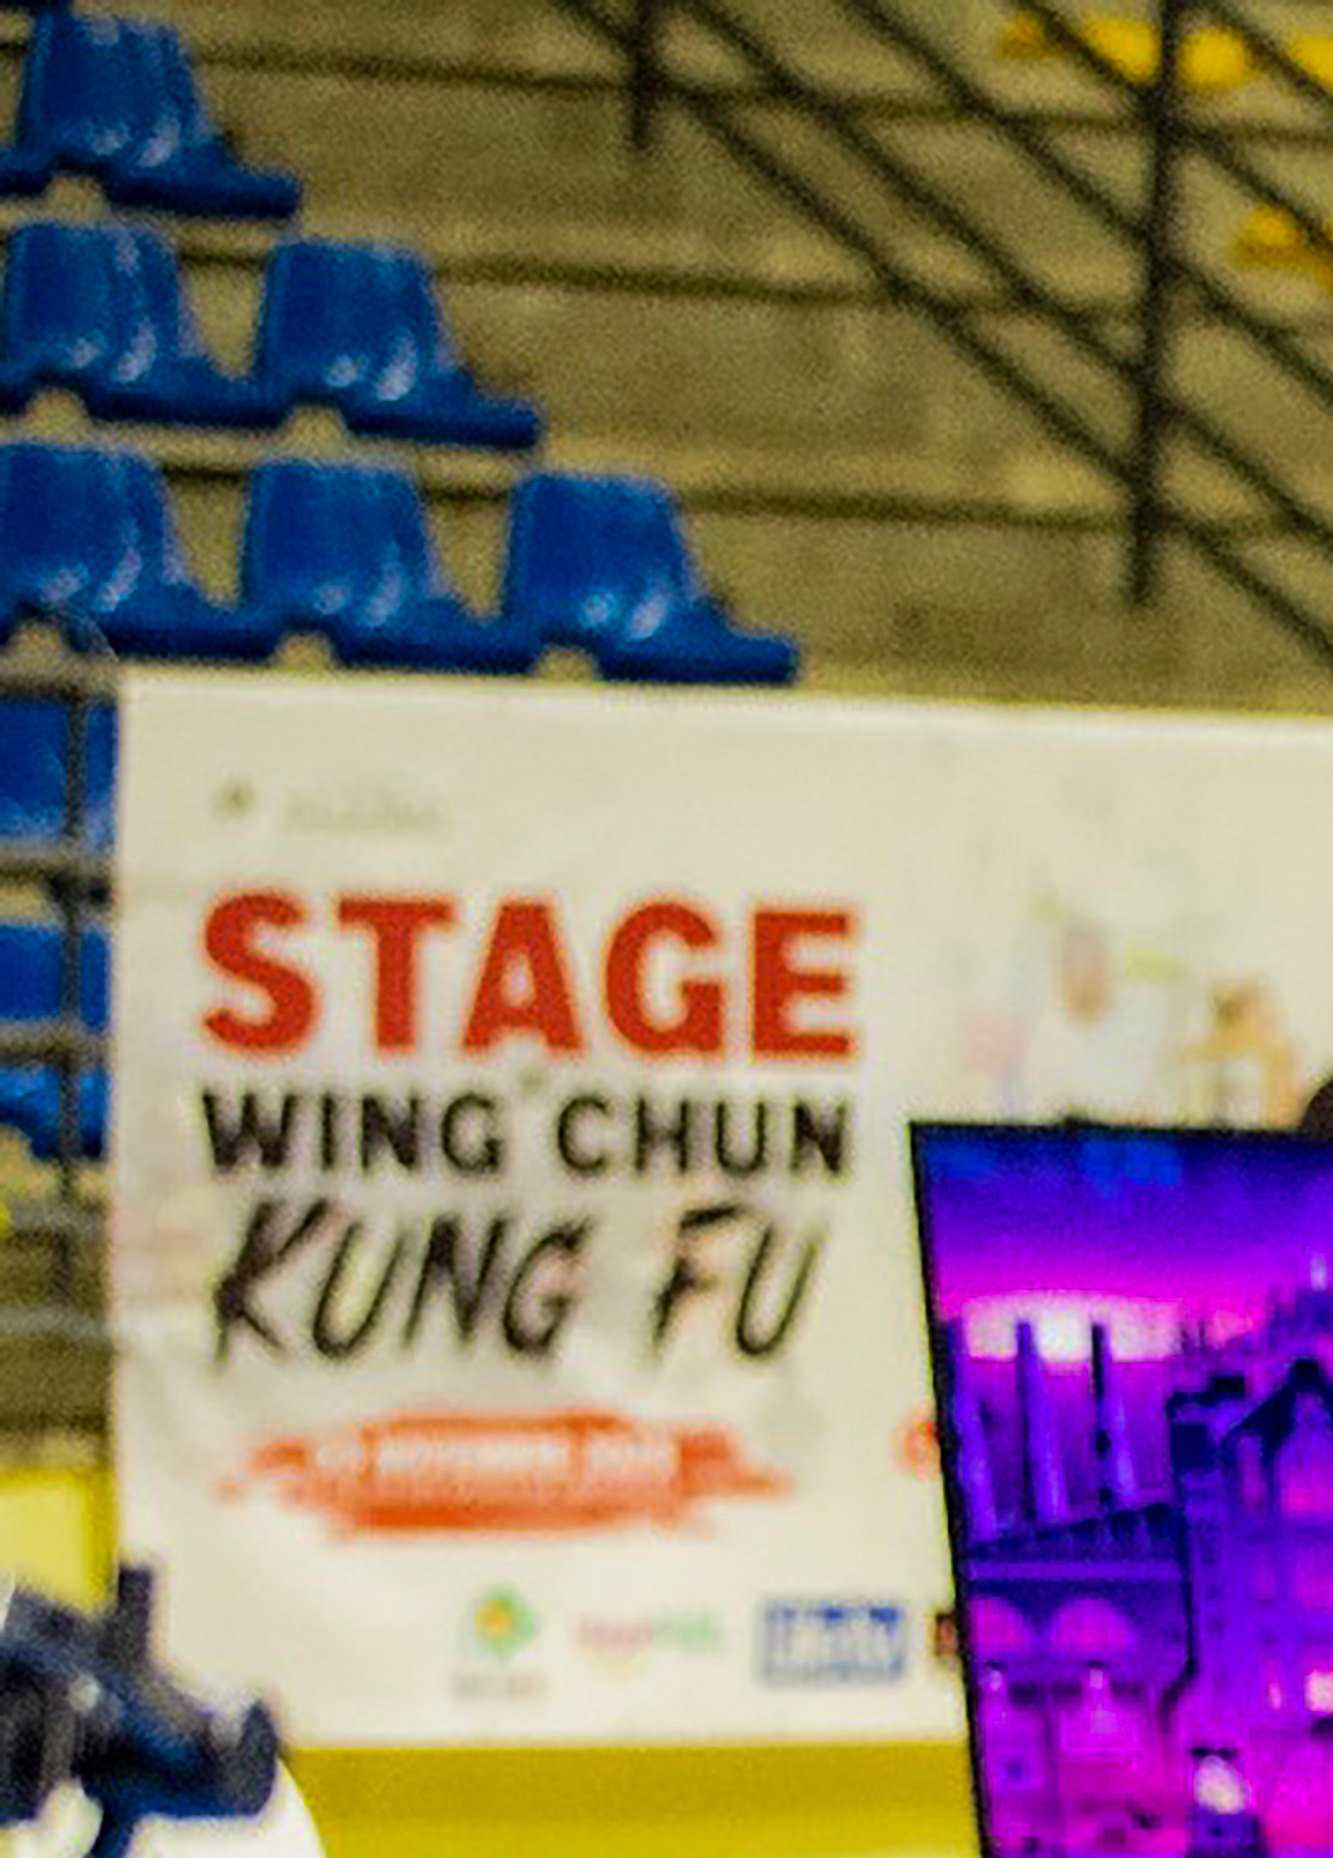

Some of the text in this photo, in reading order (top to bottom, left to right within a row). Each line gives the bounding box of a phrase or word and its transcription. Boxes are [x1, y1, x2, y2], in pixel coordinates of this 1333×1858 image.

[203, 892, 855, 1058] STAGE
[203, 1090, 850, 1177] WING CHUN
[213, 1196, 825, 1361] KUNG FU
